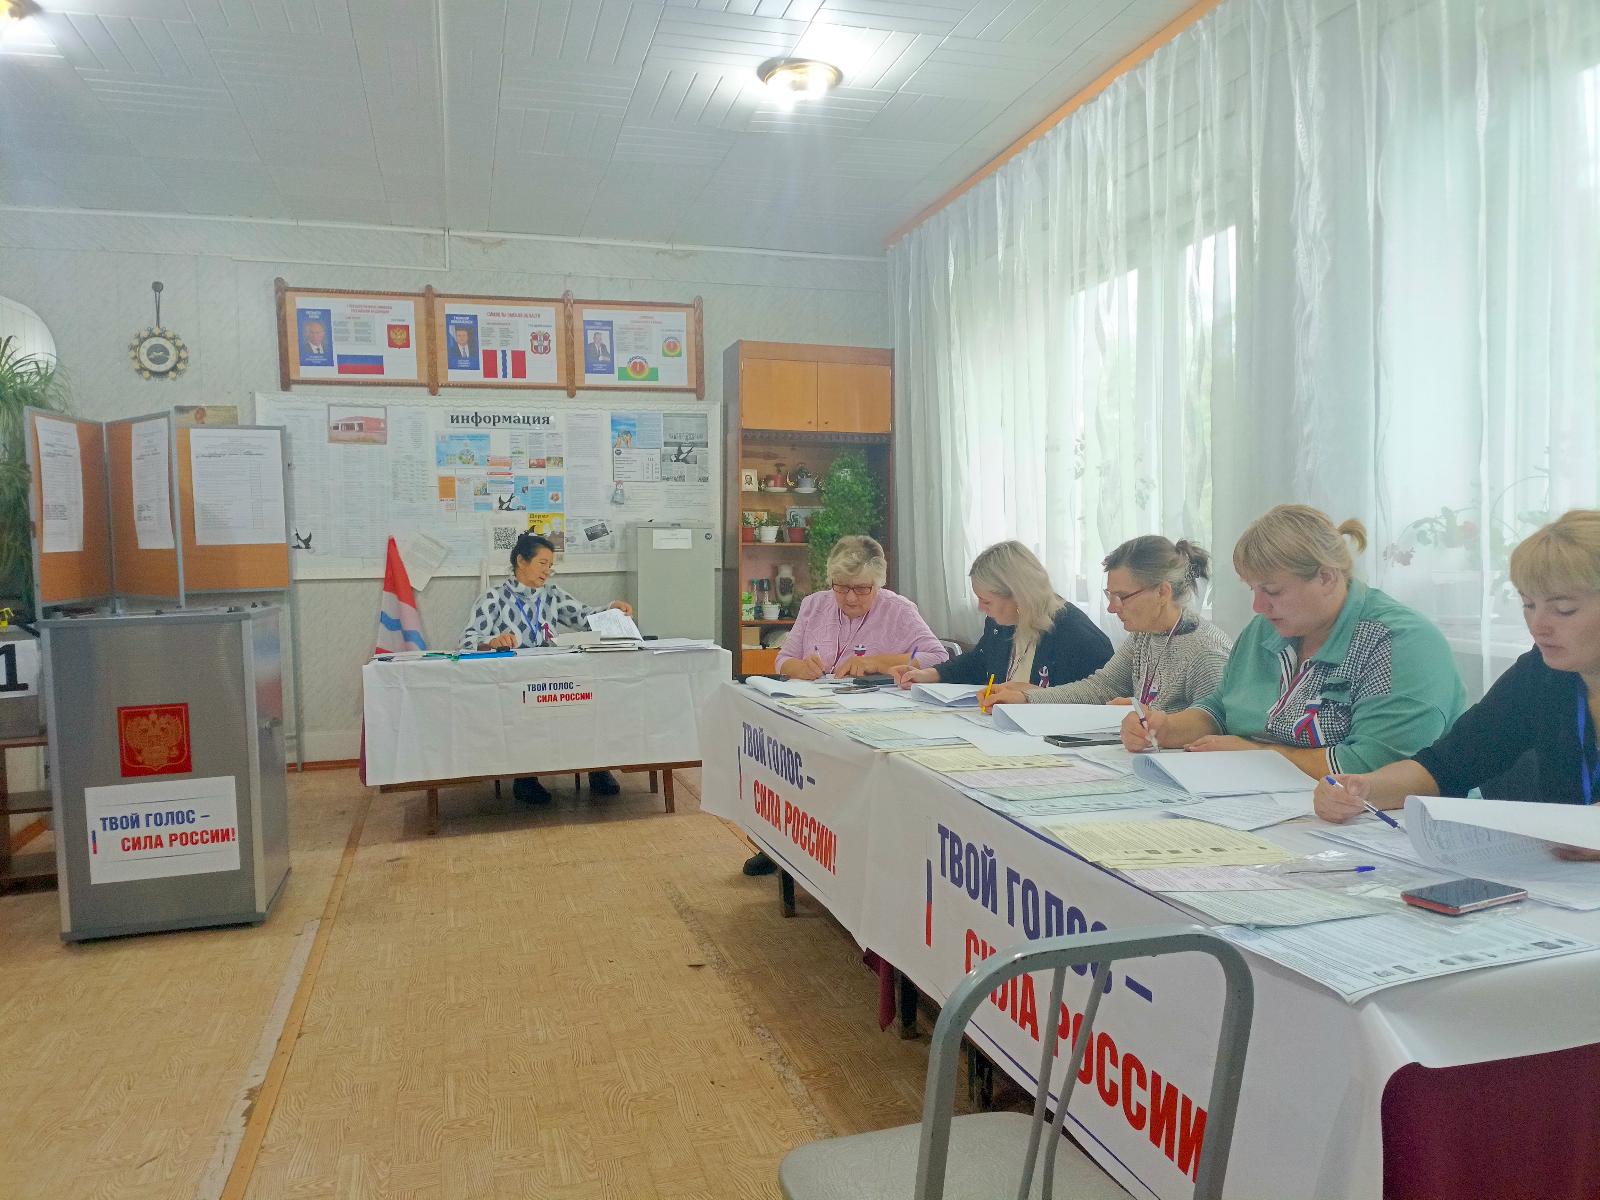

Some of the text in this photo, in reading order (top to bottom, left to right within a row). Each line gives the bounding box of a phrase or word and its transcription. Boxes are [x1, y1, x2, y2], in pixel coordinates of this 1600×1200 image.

[450, 411, 550, 427] информация
[0, 644, 28, 691] 1
[527, 683, 547, 692] ТВОЙ
[549, 682, 574, 691] ГОЛОС
[537, 692, 593, 703] СИЛА РОССИИ!
[743, 721, 767, 766] ТВОЙ
[767, 736, 803, 790] ГОЛОС
[100, 812, 140, 831] ТВОЙ
[146, 809, 195, 827] ГОЛОС
[754, 779, 838, 876] СИЛА РОССИИ!
[121, 827, 236, 852] СИЛА РОССИИ!
[937, 823, 998, 916] ТВОЙ
